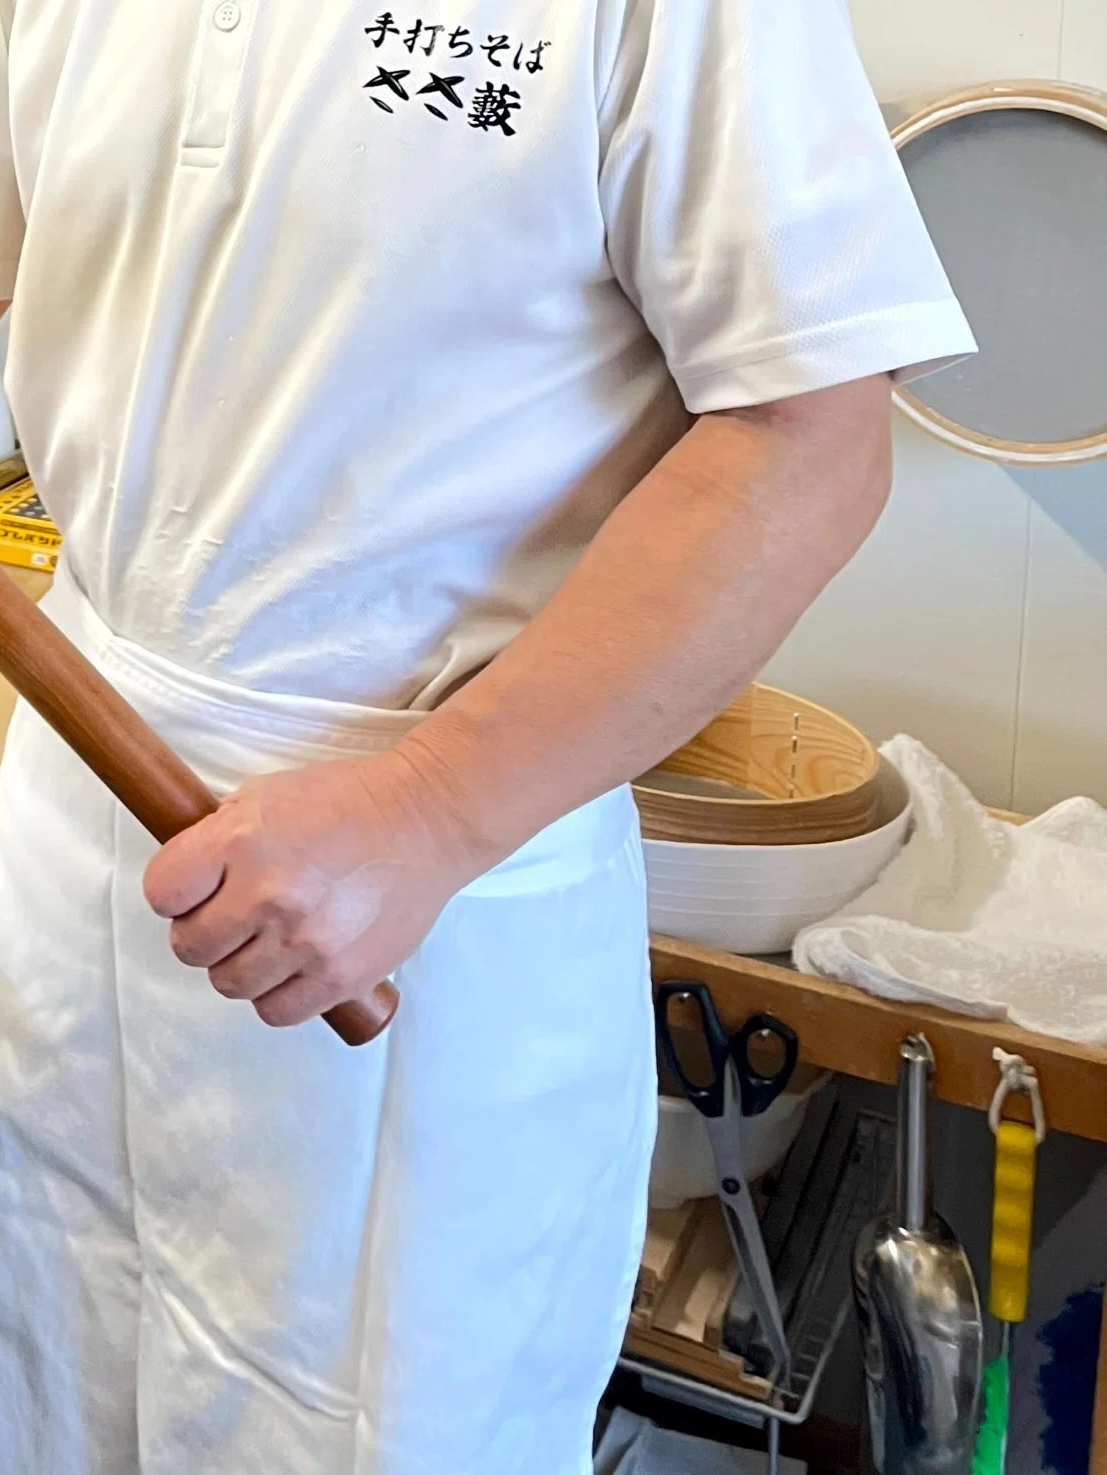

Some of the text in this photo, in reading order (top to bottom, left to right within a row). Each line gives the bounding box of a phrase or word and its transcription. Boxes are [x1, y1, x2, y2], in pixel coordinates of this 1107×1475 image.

[364, 12, 552, 74] 手打ちそば
